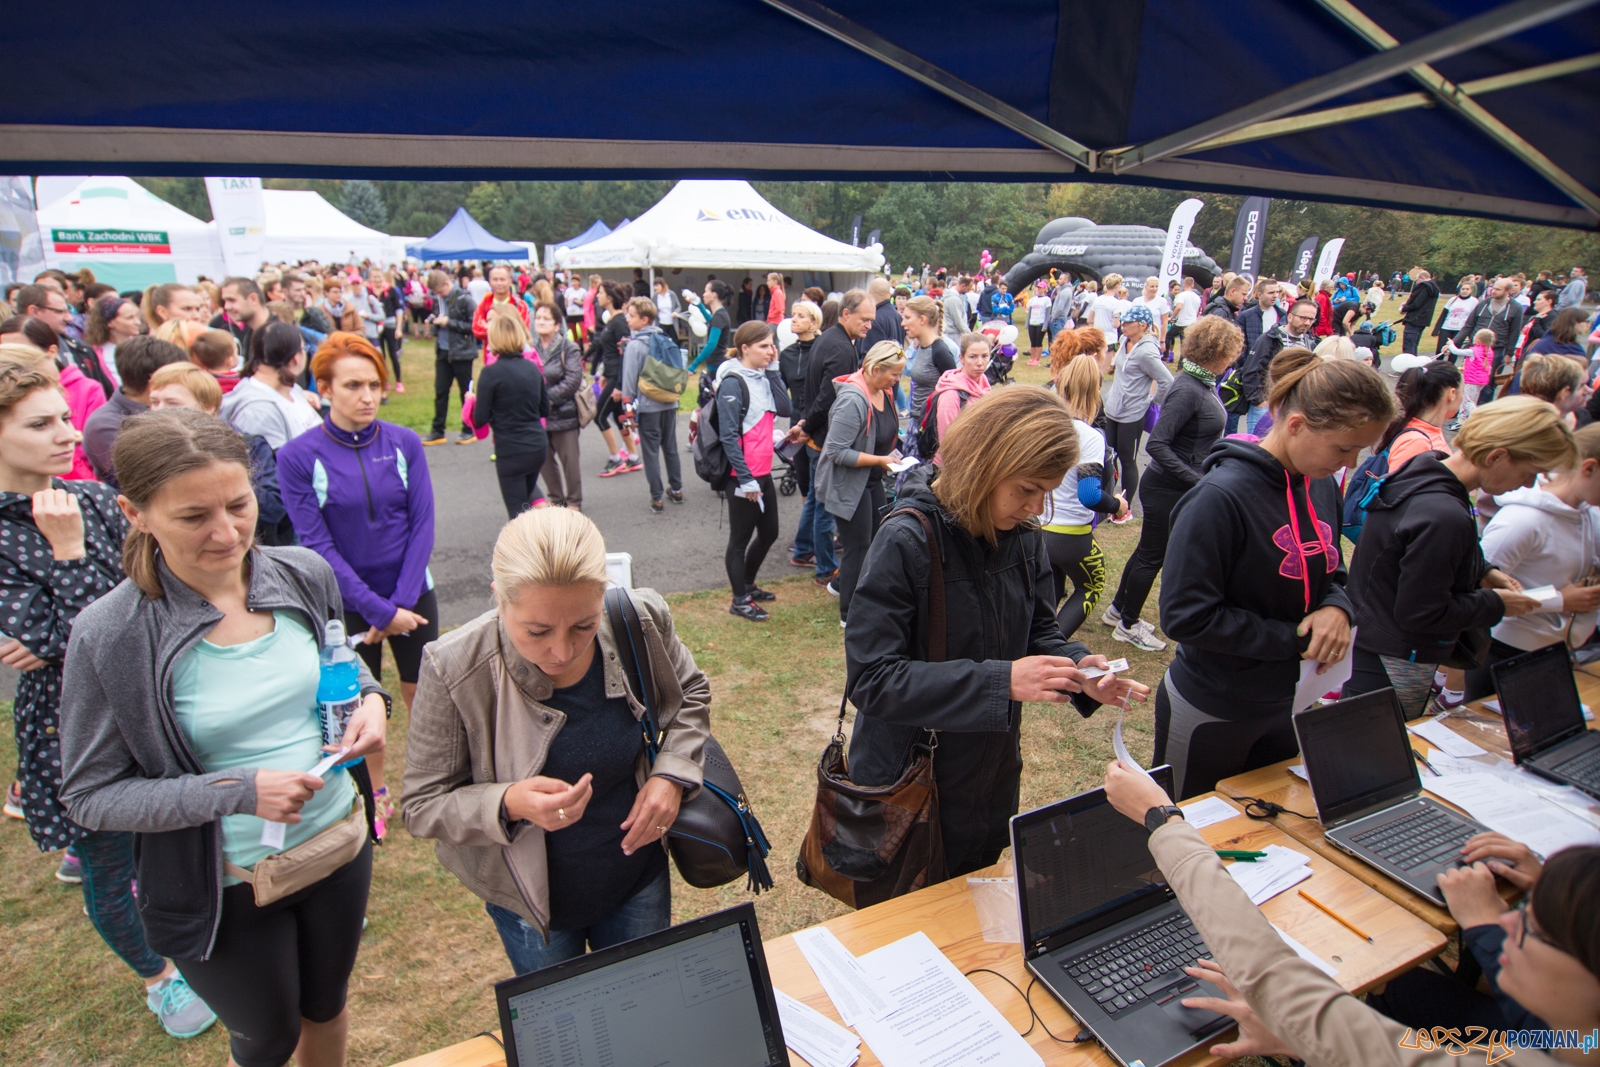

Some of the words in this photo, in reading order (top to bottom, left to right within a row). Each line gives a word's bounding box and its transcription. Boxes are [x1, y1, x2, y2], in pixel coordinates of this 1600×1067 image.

[57, 231, 85, 242] Bank
[88, 231, 135, 243] Zachodni
[137, 232, 163, 243] WBK
[1171, 224, 1184, 259] VOYAGER
[1241, 210, 1259, 270] mazda
[1295, 250, 1312, 279] Jeep
